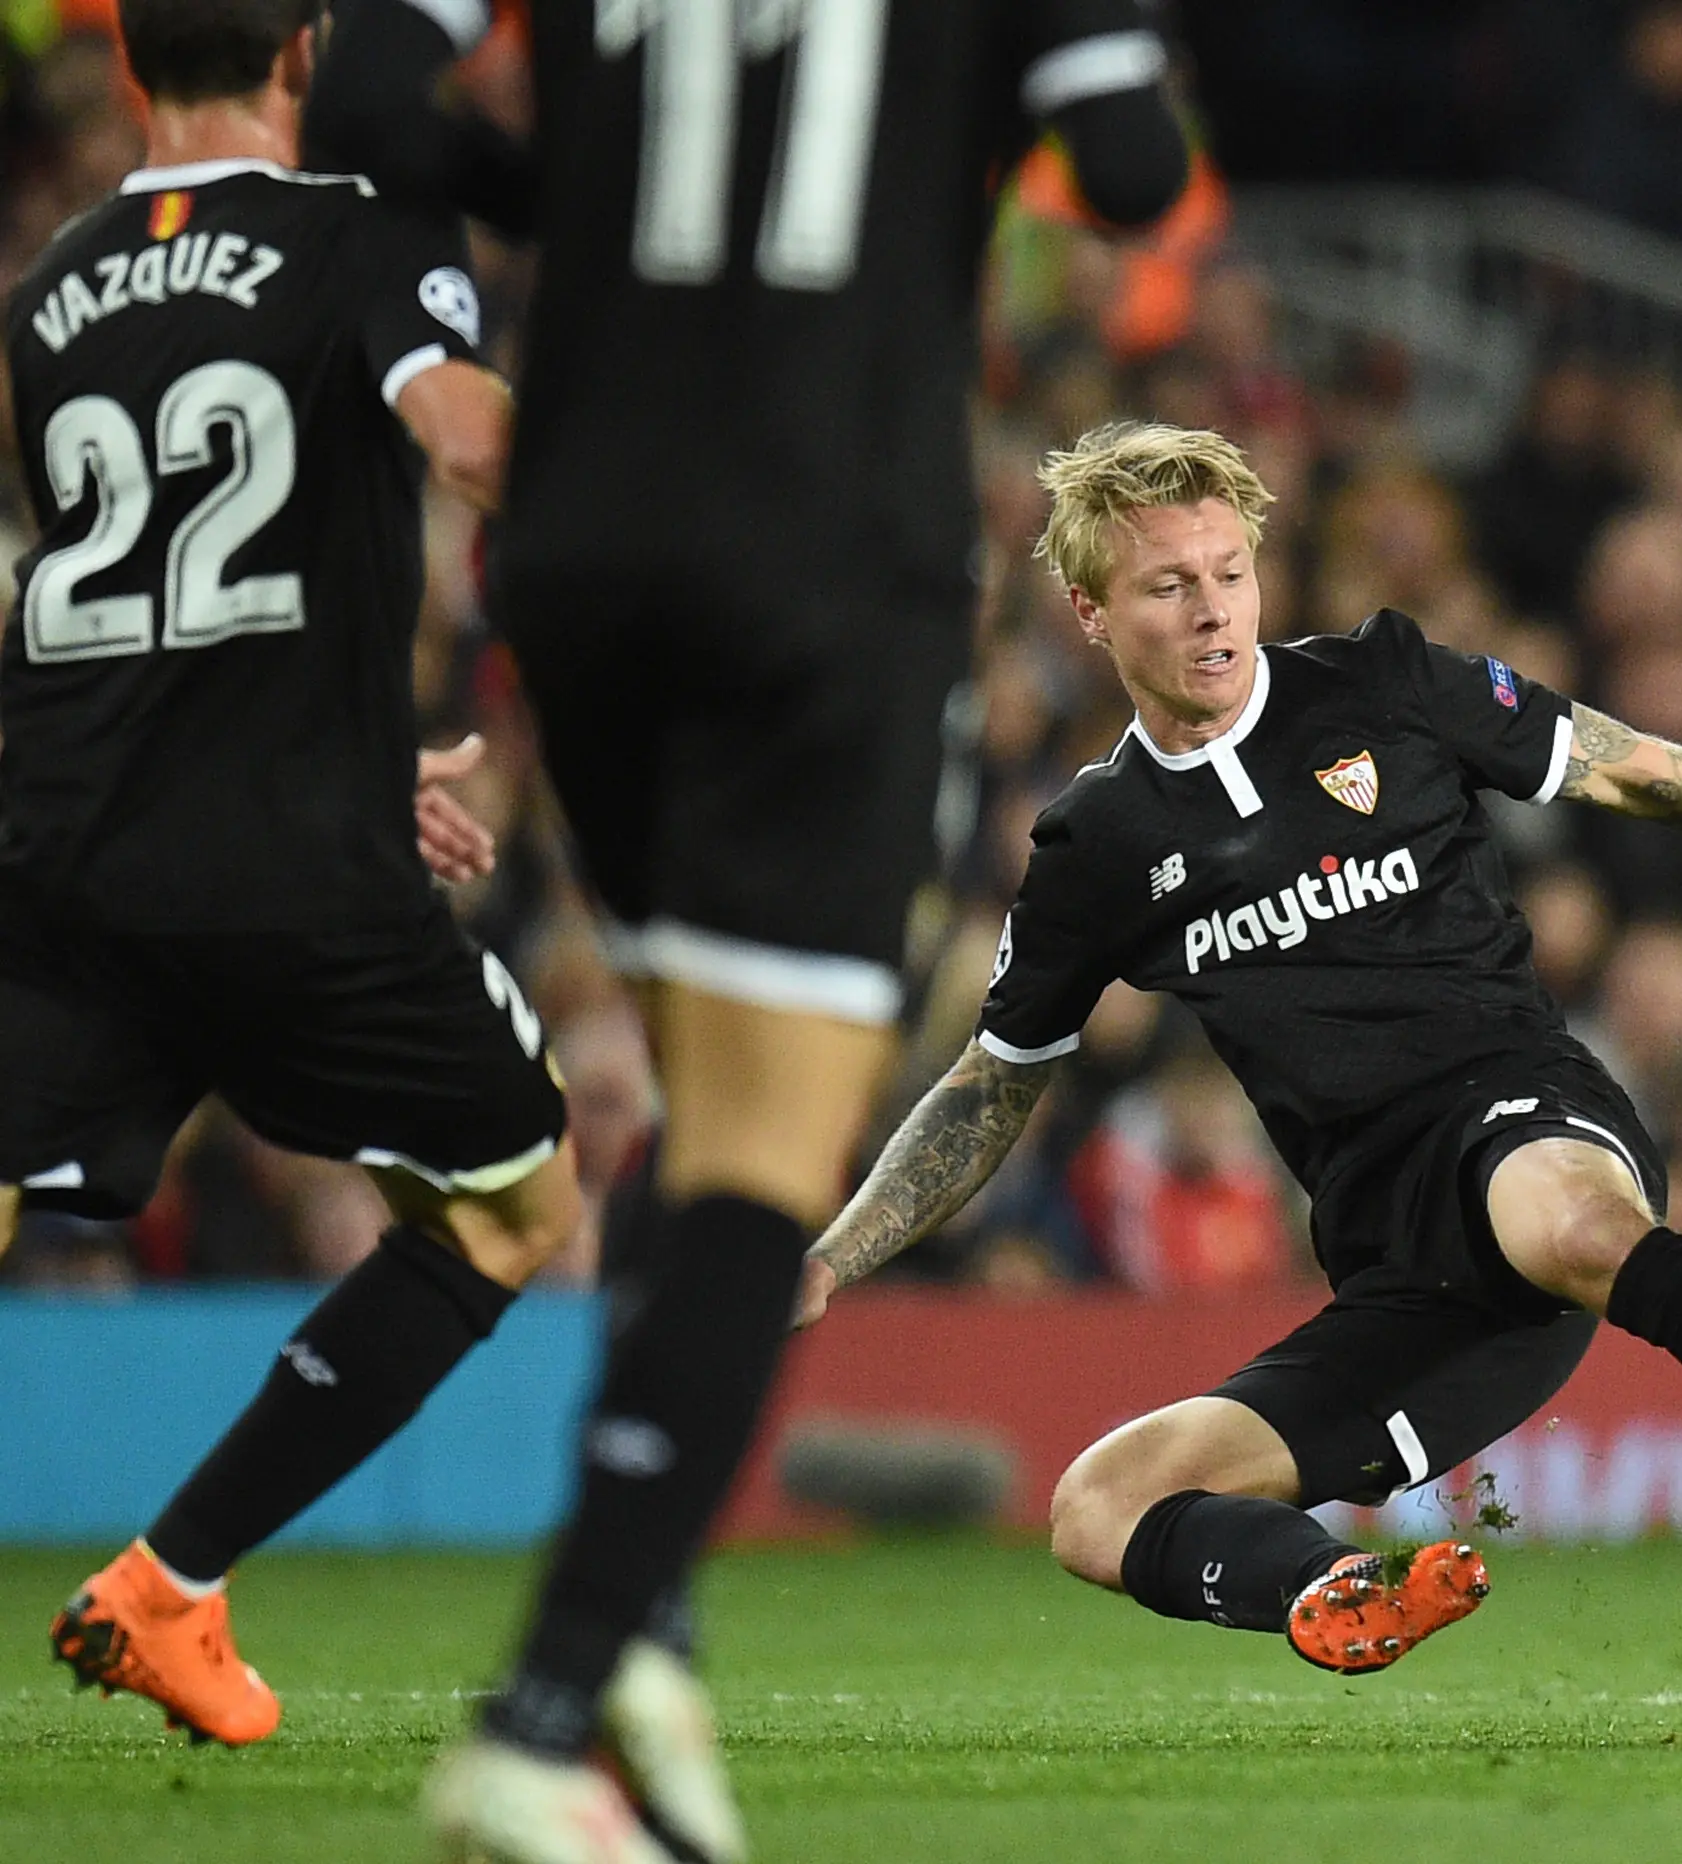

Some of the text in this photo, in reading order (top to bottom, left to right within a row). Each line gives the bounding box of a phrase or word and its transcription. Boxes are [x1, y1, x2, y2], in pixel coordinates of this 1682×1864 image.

[594, 0, 891, 291] 11
[32, 231, 283, 354] VAZQUEZ
[24, 359, 305, 664] 22
[1185, 847, 1419, 975] Playtika
